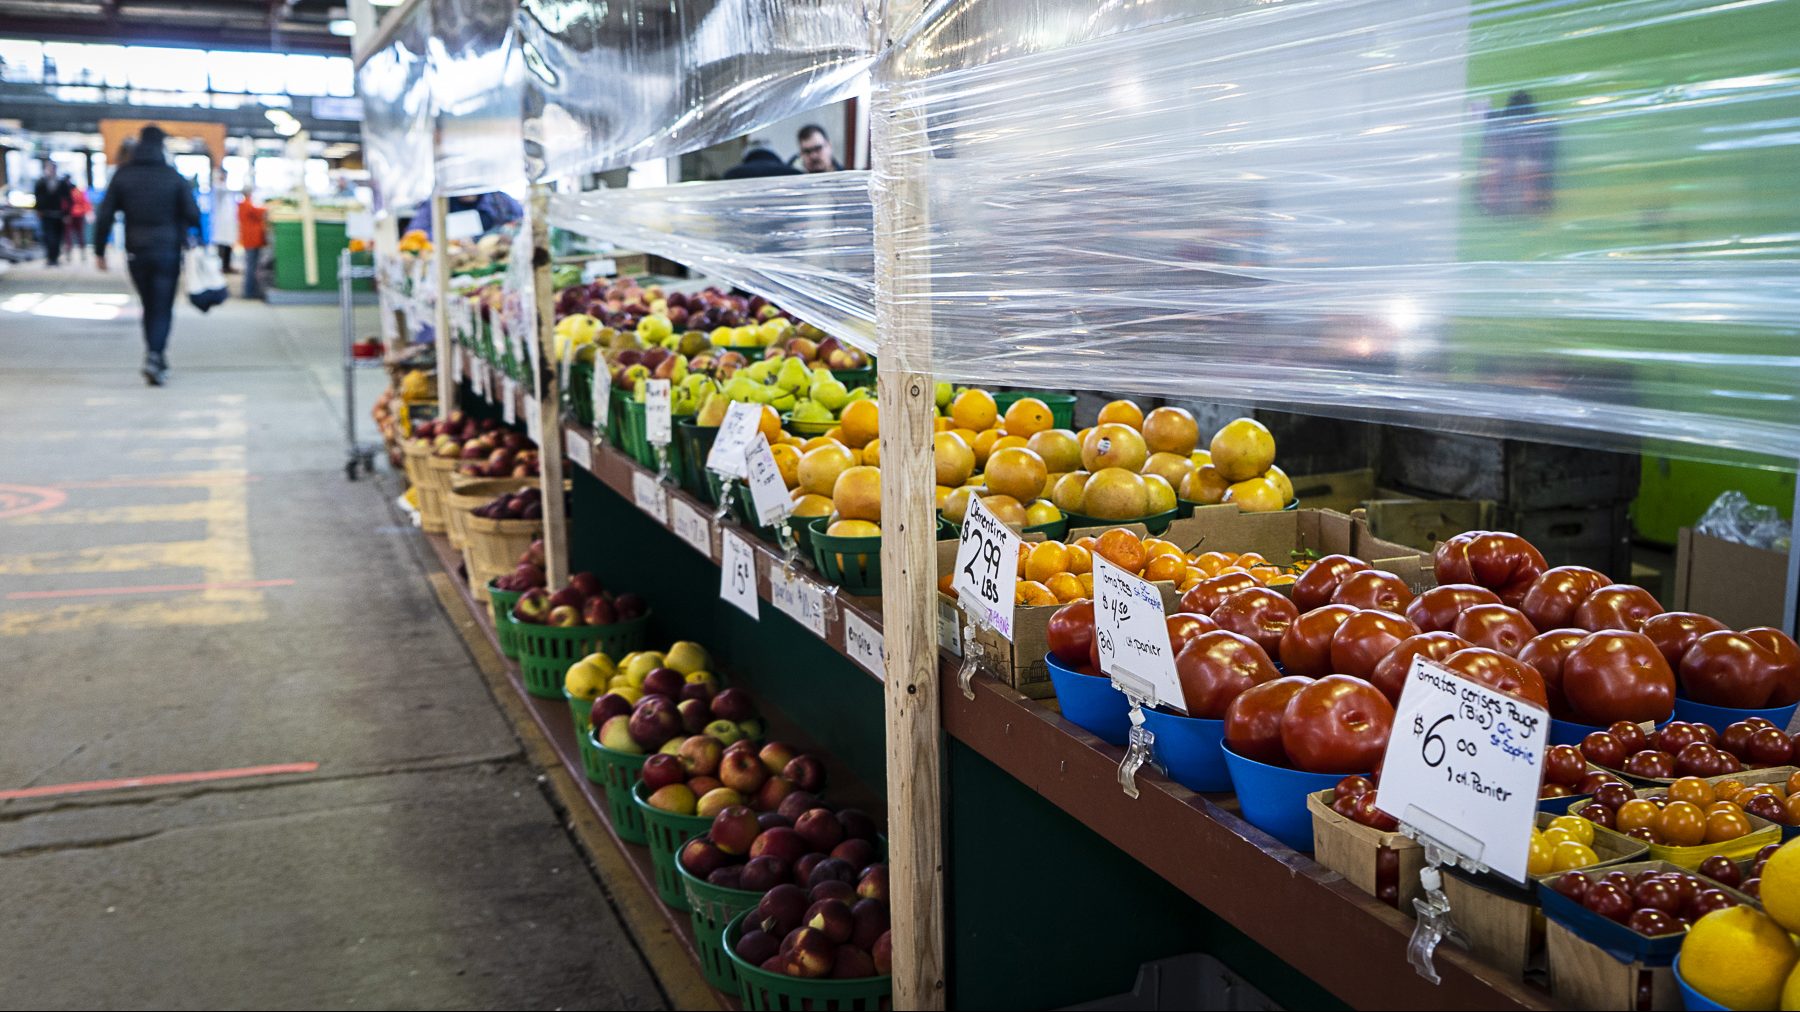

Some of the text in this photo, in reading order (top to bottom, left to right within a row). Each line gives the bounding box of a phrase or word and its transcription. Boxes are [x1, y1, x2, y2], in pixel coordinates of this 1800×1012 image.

[981, 575, 999, 604] LBS
[1100, 565, 1133, 598] Tomates
[1416, 662, 1457, 696] Tomates
[1459, 701, 1494, 731] (Bio)
